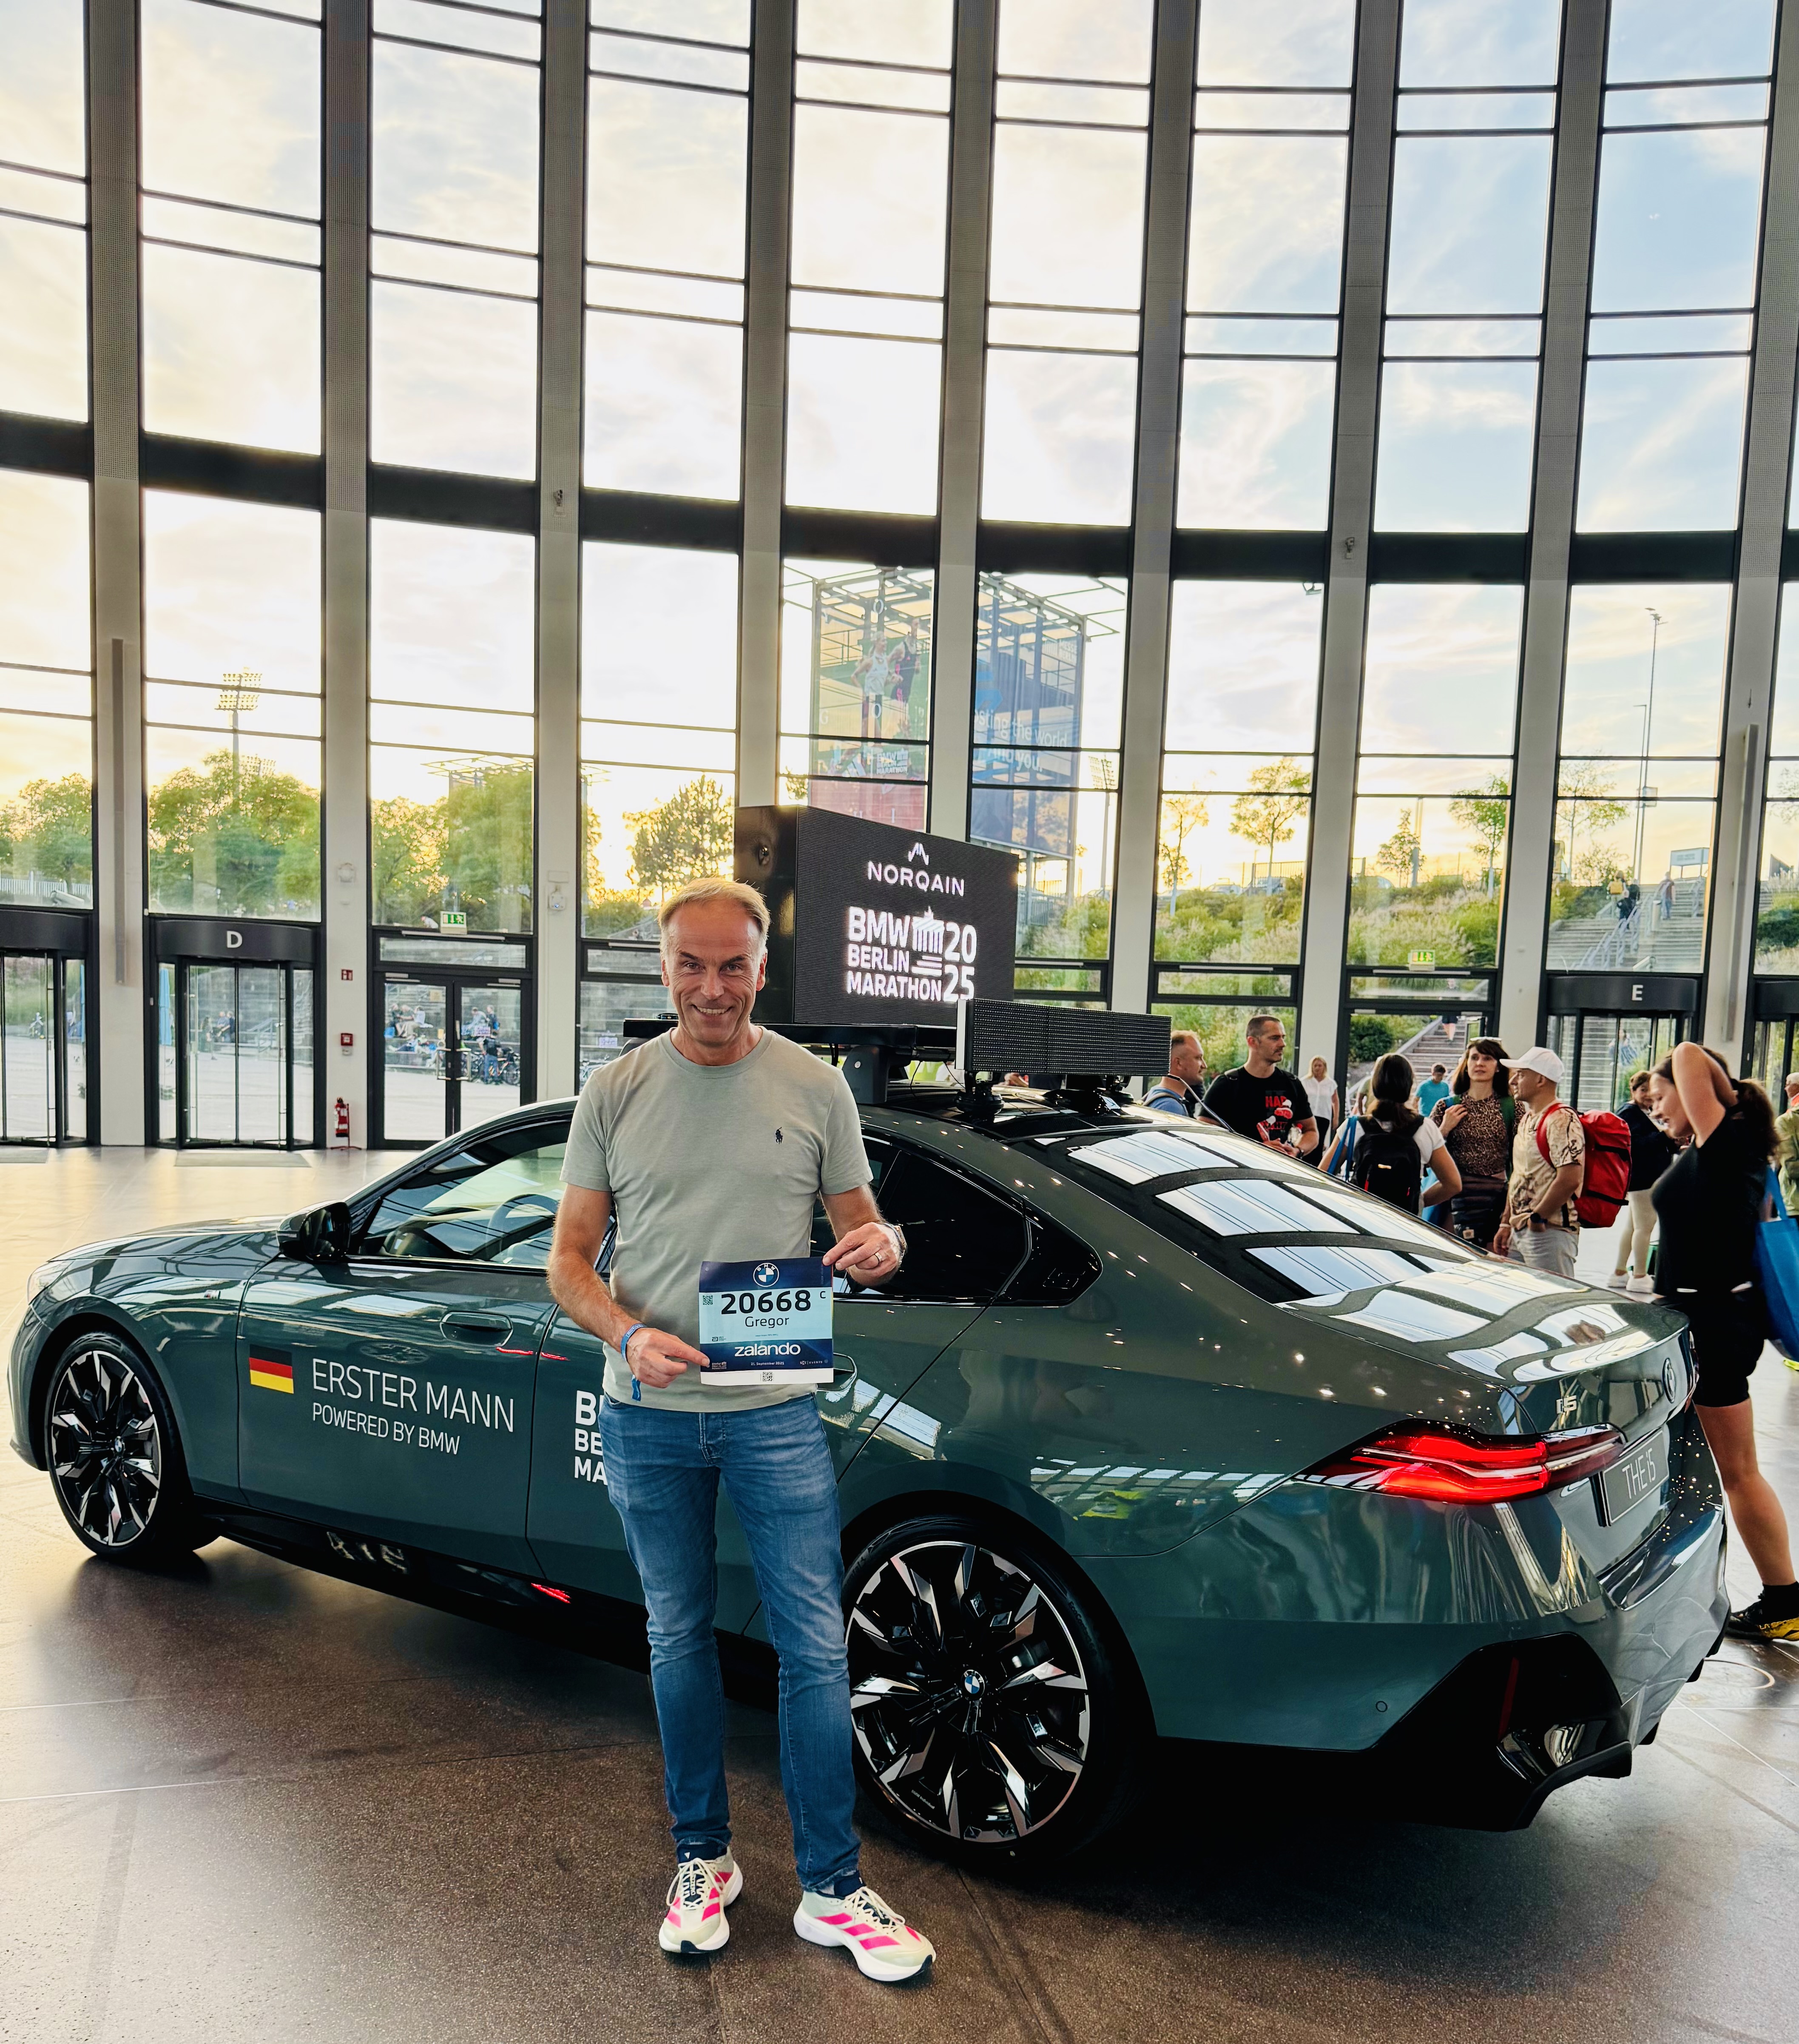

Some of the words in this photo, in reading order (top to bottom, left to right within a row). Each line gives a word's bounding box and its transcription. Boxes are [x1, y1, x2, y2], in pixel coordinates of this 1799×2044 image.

[1012, 717, 1032, 741] the
[1035, 729, 1068, 747] world
[876, 766, 908, 775] MARATHON
[867, 861, 965, 897] NORQAIN
[227, 931, 242, 948] D
[848, 906, 911, 948] BMW
[944, 922, 978, 964] 20
[848, 943, 910, 973] BERLIN
[847, 970, 942, 1002] MARATHON
[943, 964, 975, 1002] 25
[1632, 985, 1643, 1001] E
[721, 1290, 811, 1315] 20668
[820, 1291, 826, 1299] C
[745, 1316, 790, 1328] Gregor
[734, 1342, 801, 1357] zalando
[313, 1358, 418, 1412] ERSTER
[426, 1381, 514, 1432] MANN
[313, 1402, 389, 1438] POWERED
[393, 1421, 415, 1444] BY
[419, 1427, 460, 1455] BMW
[1622, 1455, 1648, 1499] THE
[1646, 1448, 1656, 1483] i5
